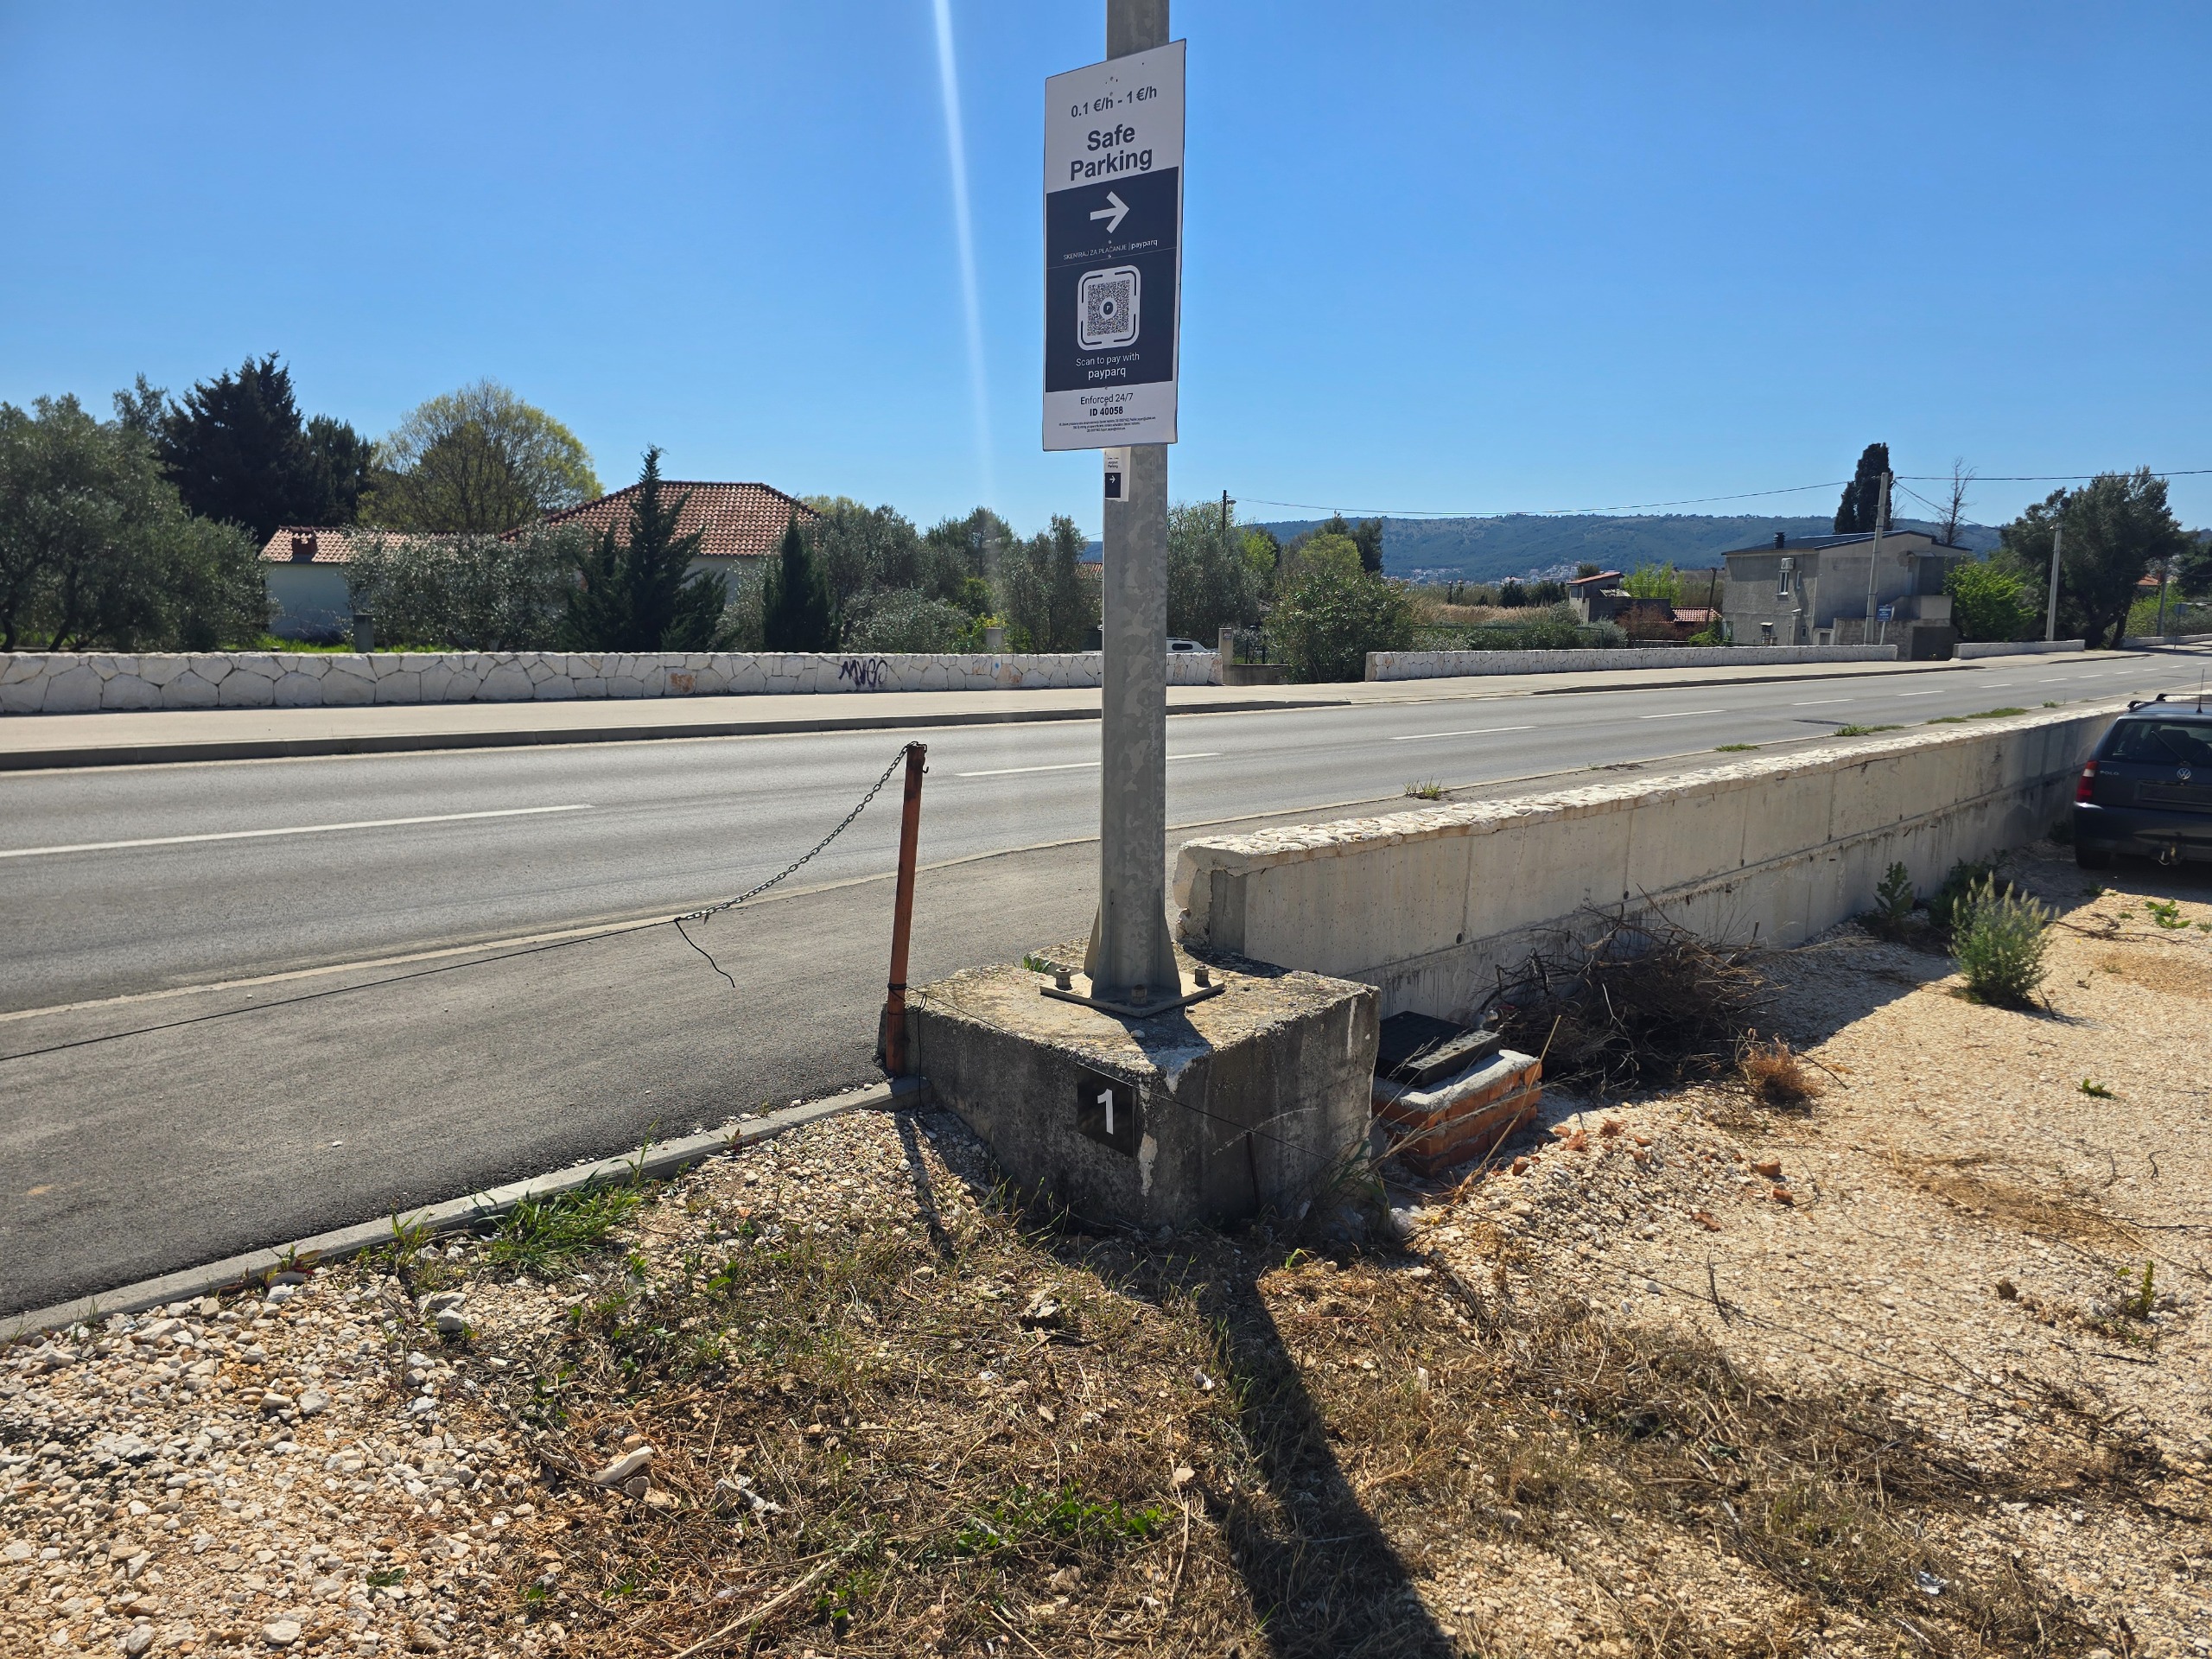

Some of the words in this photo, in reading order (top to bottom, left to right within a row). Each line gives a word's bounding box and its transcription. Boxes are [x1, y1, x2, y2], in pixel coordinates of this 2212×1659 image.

[1071, 102, 1089, 118] 0.1
[1093, 97, 1114, 112] €/h
[1127, 91, 1133, 104] 1
[1136, 86, 1157, 102] €/h
[1087, 124, 1135, 151] Safe
[1071, 149, 1153, 181] Parking
[1131, 238, 1158, 251] payparq
[1076, 358, 1095, 367] Scan
[1096, 356, 1104, 365] to
[1107, 354, 1122, 365] pay
[1122, 352, 1140, 362] with
[1088, 367, 1126, 381] payparq
[1080, 394, 1114, 405] Enforced
[1115, 392, 1134, 403] 24/7
[1090, 408, 1097, 416] ID
[1099, 405, 1123, 416] 40058
[1096, 1088, 1114, 1135] 1
